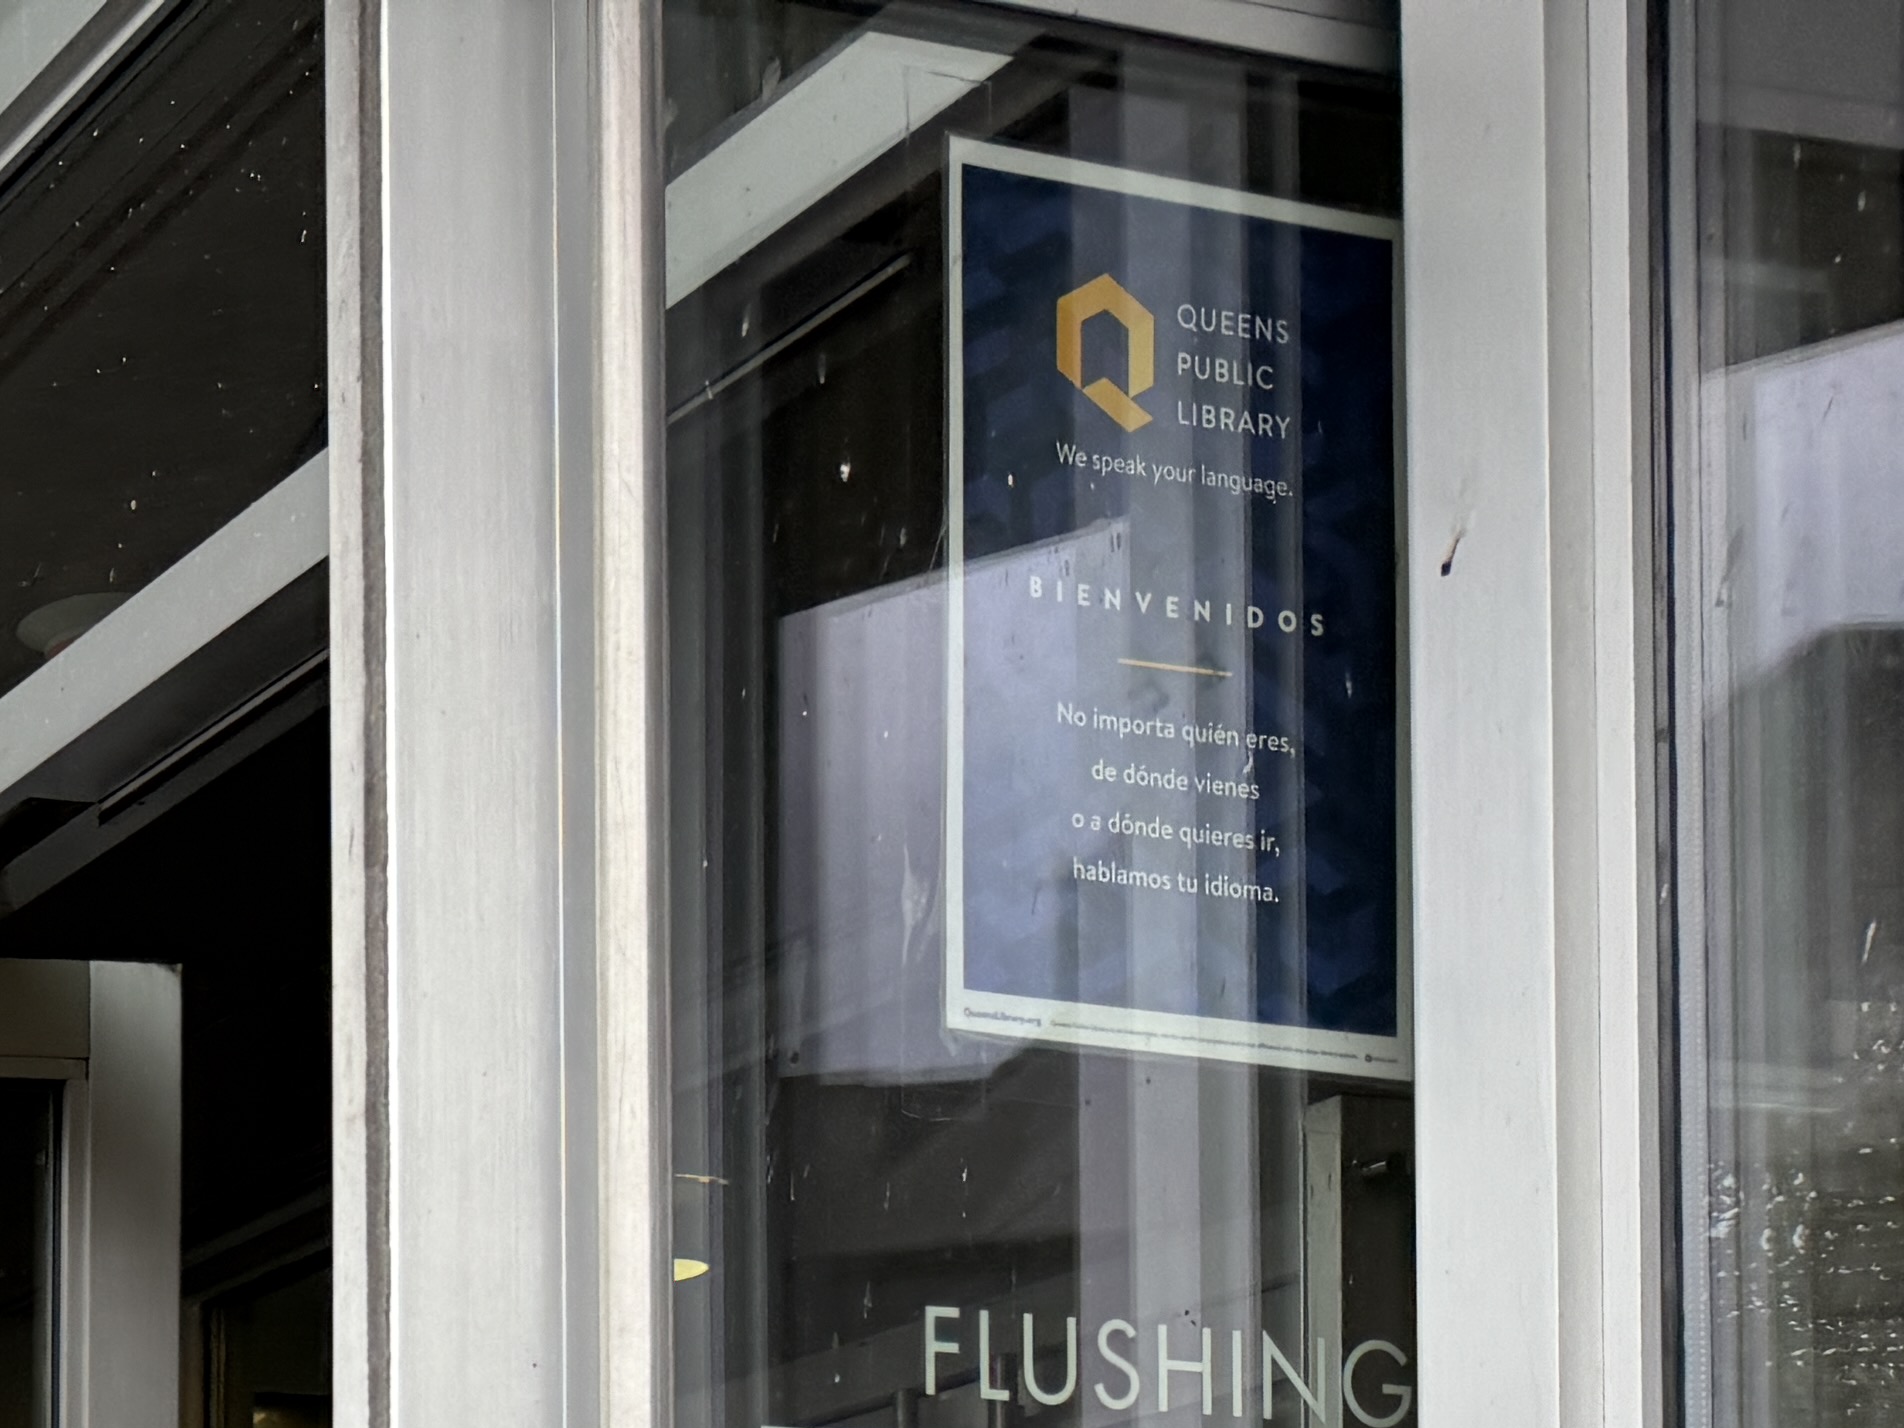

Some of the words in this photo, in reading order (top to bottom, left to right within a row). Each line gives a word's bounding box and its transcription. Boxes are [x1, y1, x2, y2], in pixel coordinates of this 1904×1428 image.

[1177, 304, 1289, 344] QUEENS
[1177, 352, 1274, 389] PUBLIC
[1178, 401, 1290, 439] LIBRARY
[1056, 441, 1087, 467] We
[1092, 453, 1146, 477] speak
[1152, 463, 1196, 486] your
[1201, 464, 1293, 500] language.
[1029, 575, 1324, 637] BIENVENIDOS
[1057, 702, 1086, 728] No
[1093, 707, 1174, 739] importa
[1182, 722, 1239, 748] quién
[1246, 733, 1295, 757] eres,
[1092, 759, 1117, 782] de
[1123, 762, 1189, 791] dónde
[1194, 773, 1260, 800] vienes
[1072, 813, 1084, 828] o
[1090, 815, 1101, 830] a
[1108, 809, 1174, 840] dónde
[1179, 823, 1254, 851] quieres
[1260, 830, 1280, 857] ir,
[1072, 856, 1171, 890] hablamos
[1177, 872, 1198, 894] tu
[1205, 873, 1279, 903] idioma.
[924, 1305, 1414, 1428] FLUSHING
